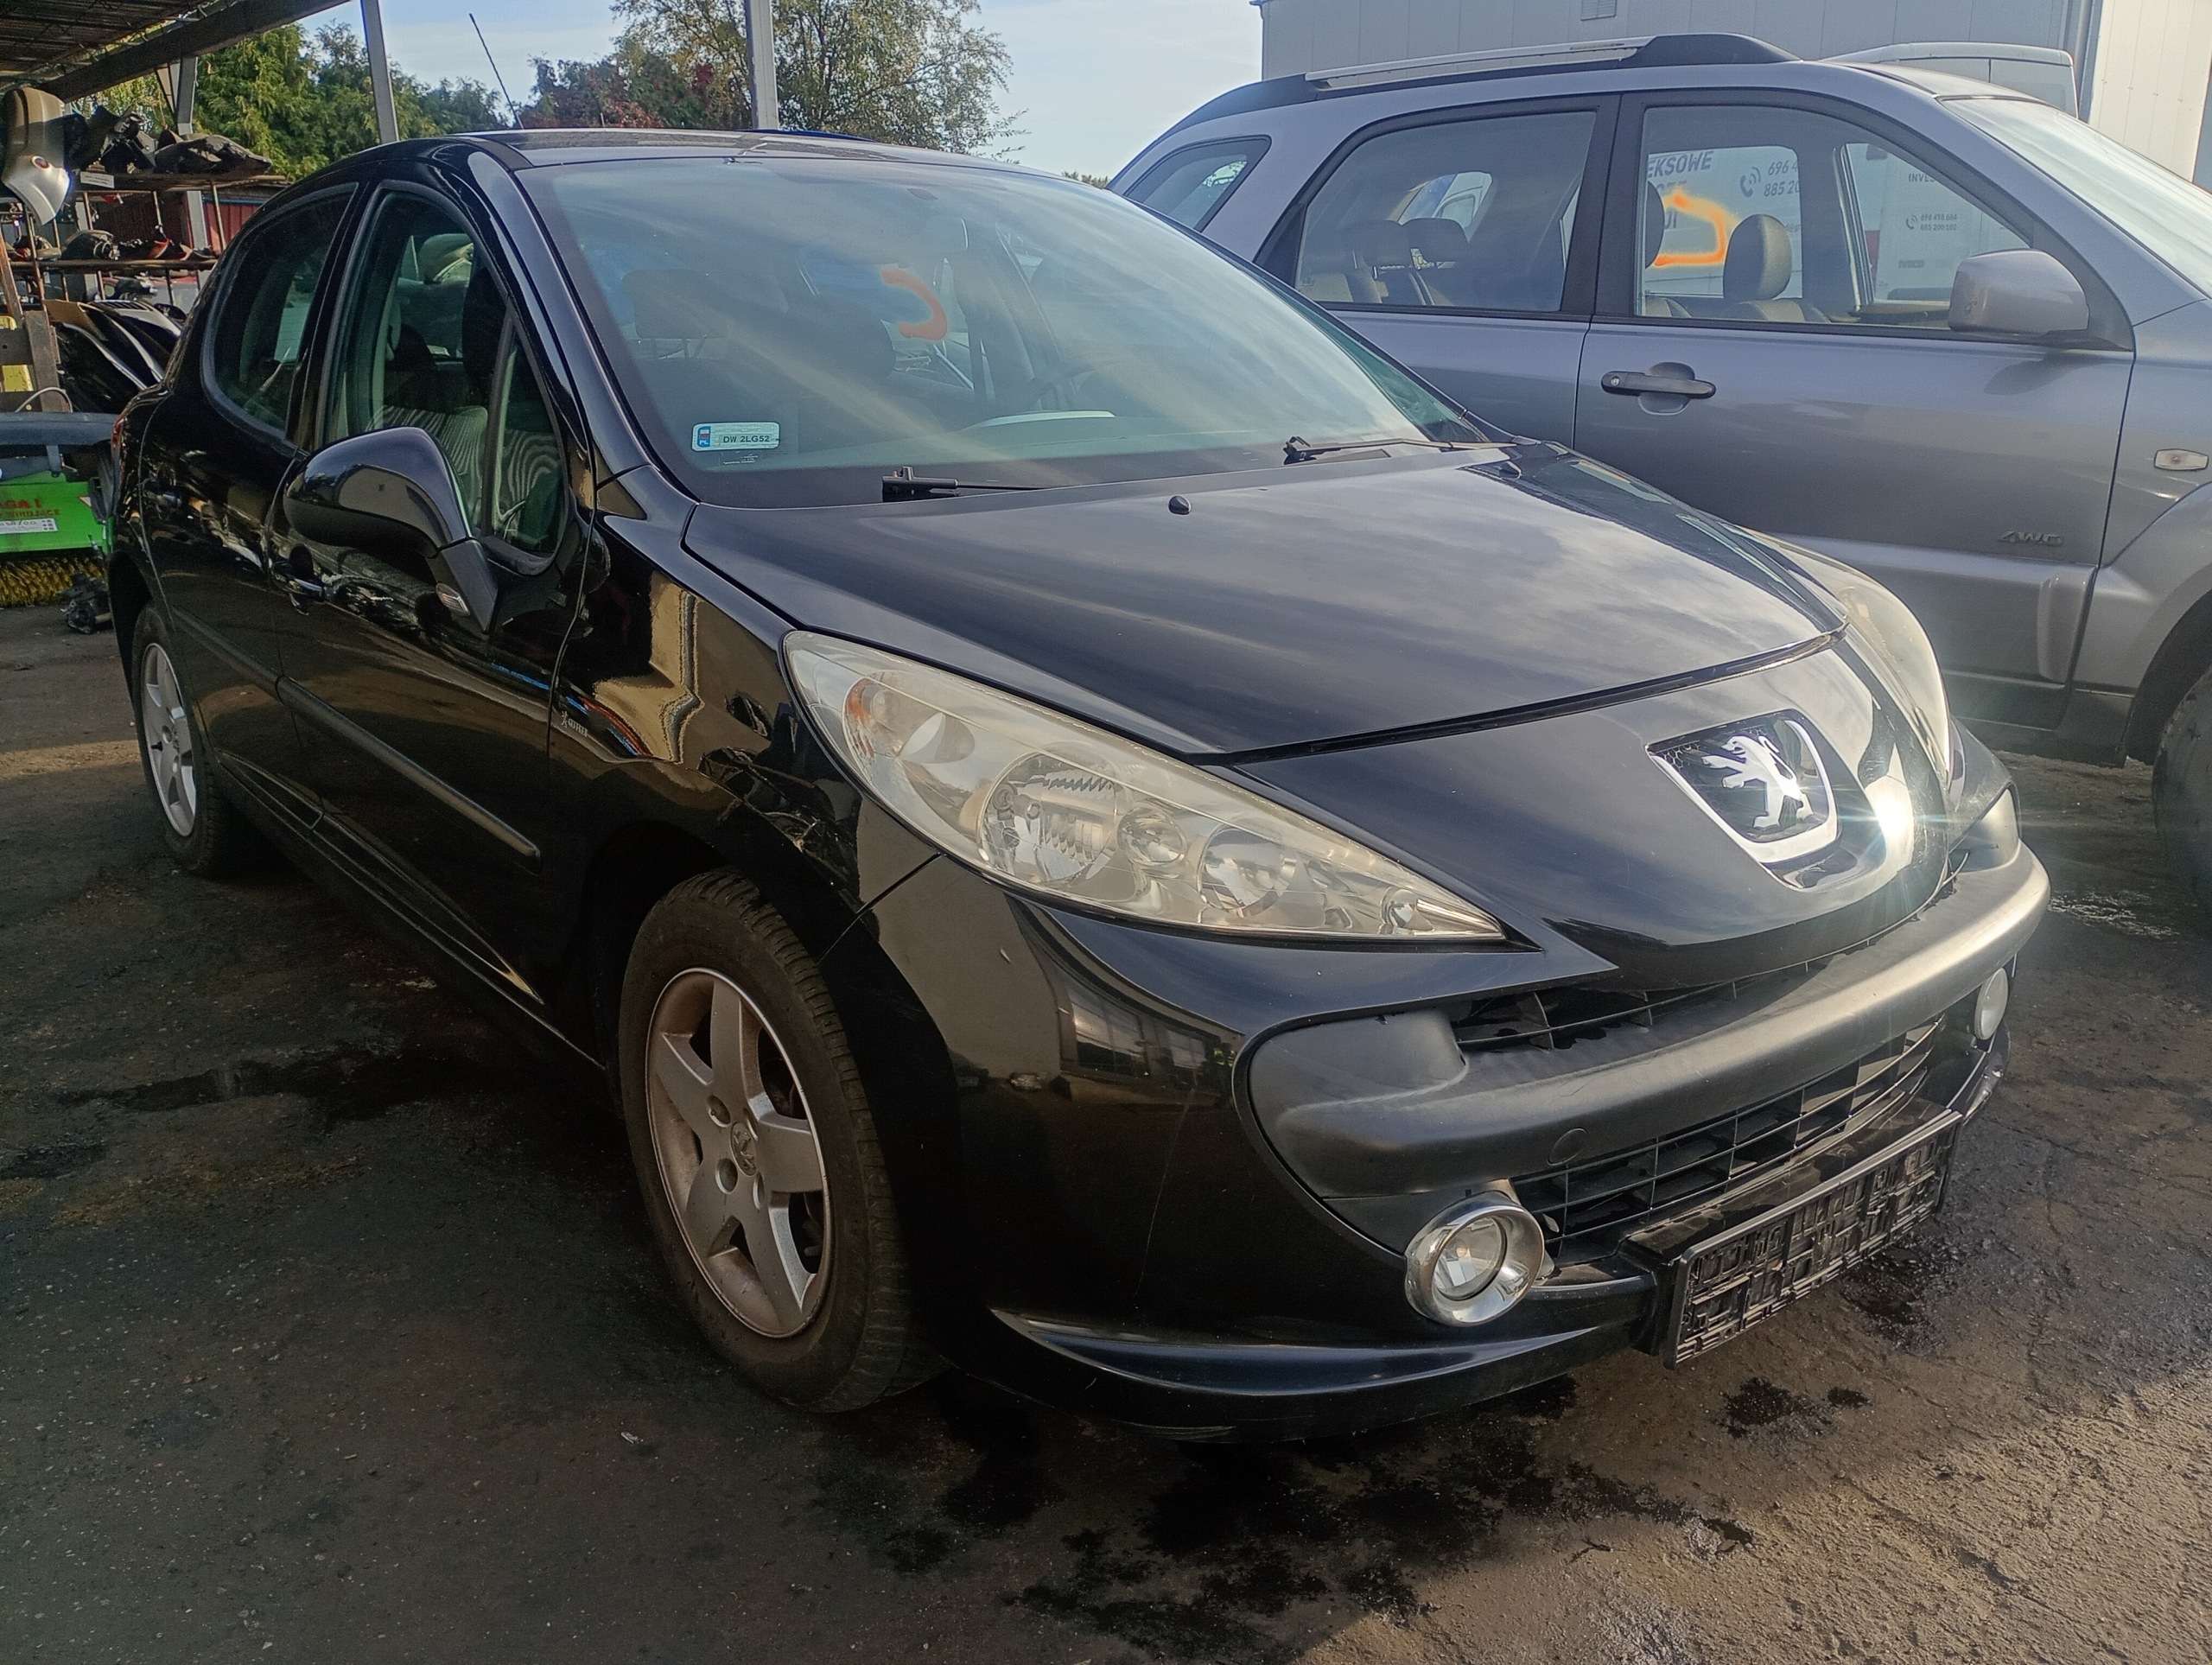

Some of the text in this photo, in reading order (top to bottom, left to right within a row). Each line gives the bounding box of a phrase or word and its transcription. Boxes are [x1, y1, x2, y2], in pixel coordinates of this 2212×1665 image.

[1768, 160, 1789, 175] 696
[1764, 181, 1785, 197] 885
[740, 435, 770, 443] 2LG52
